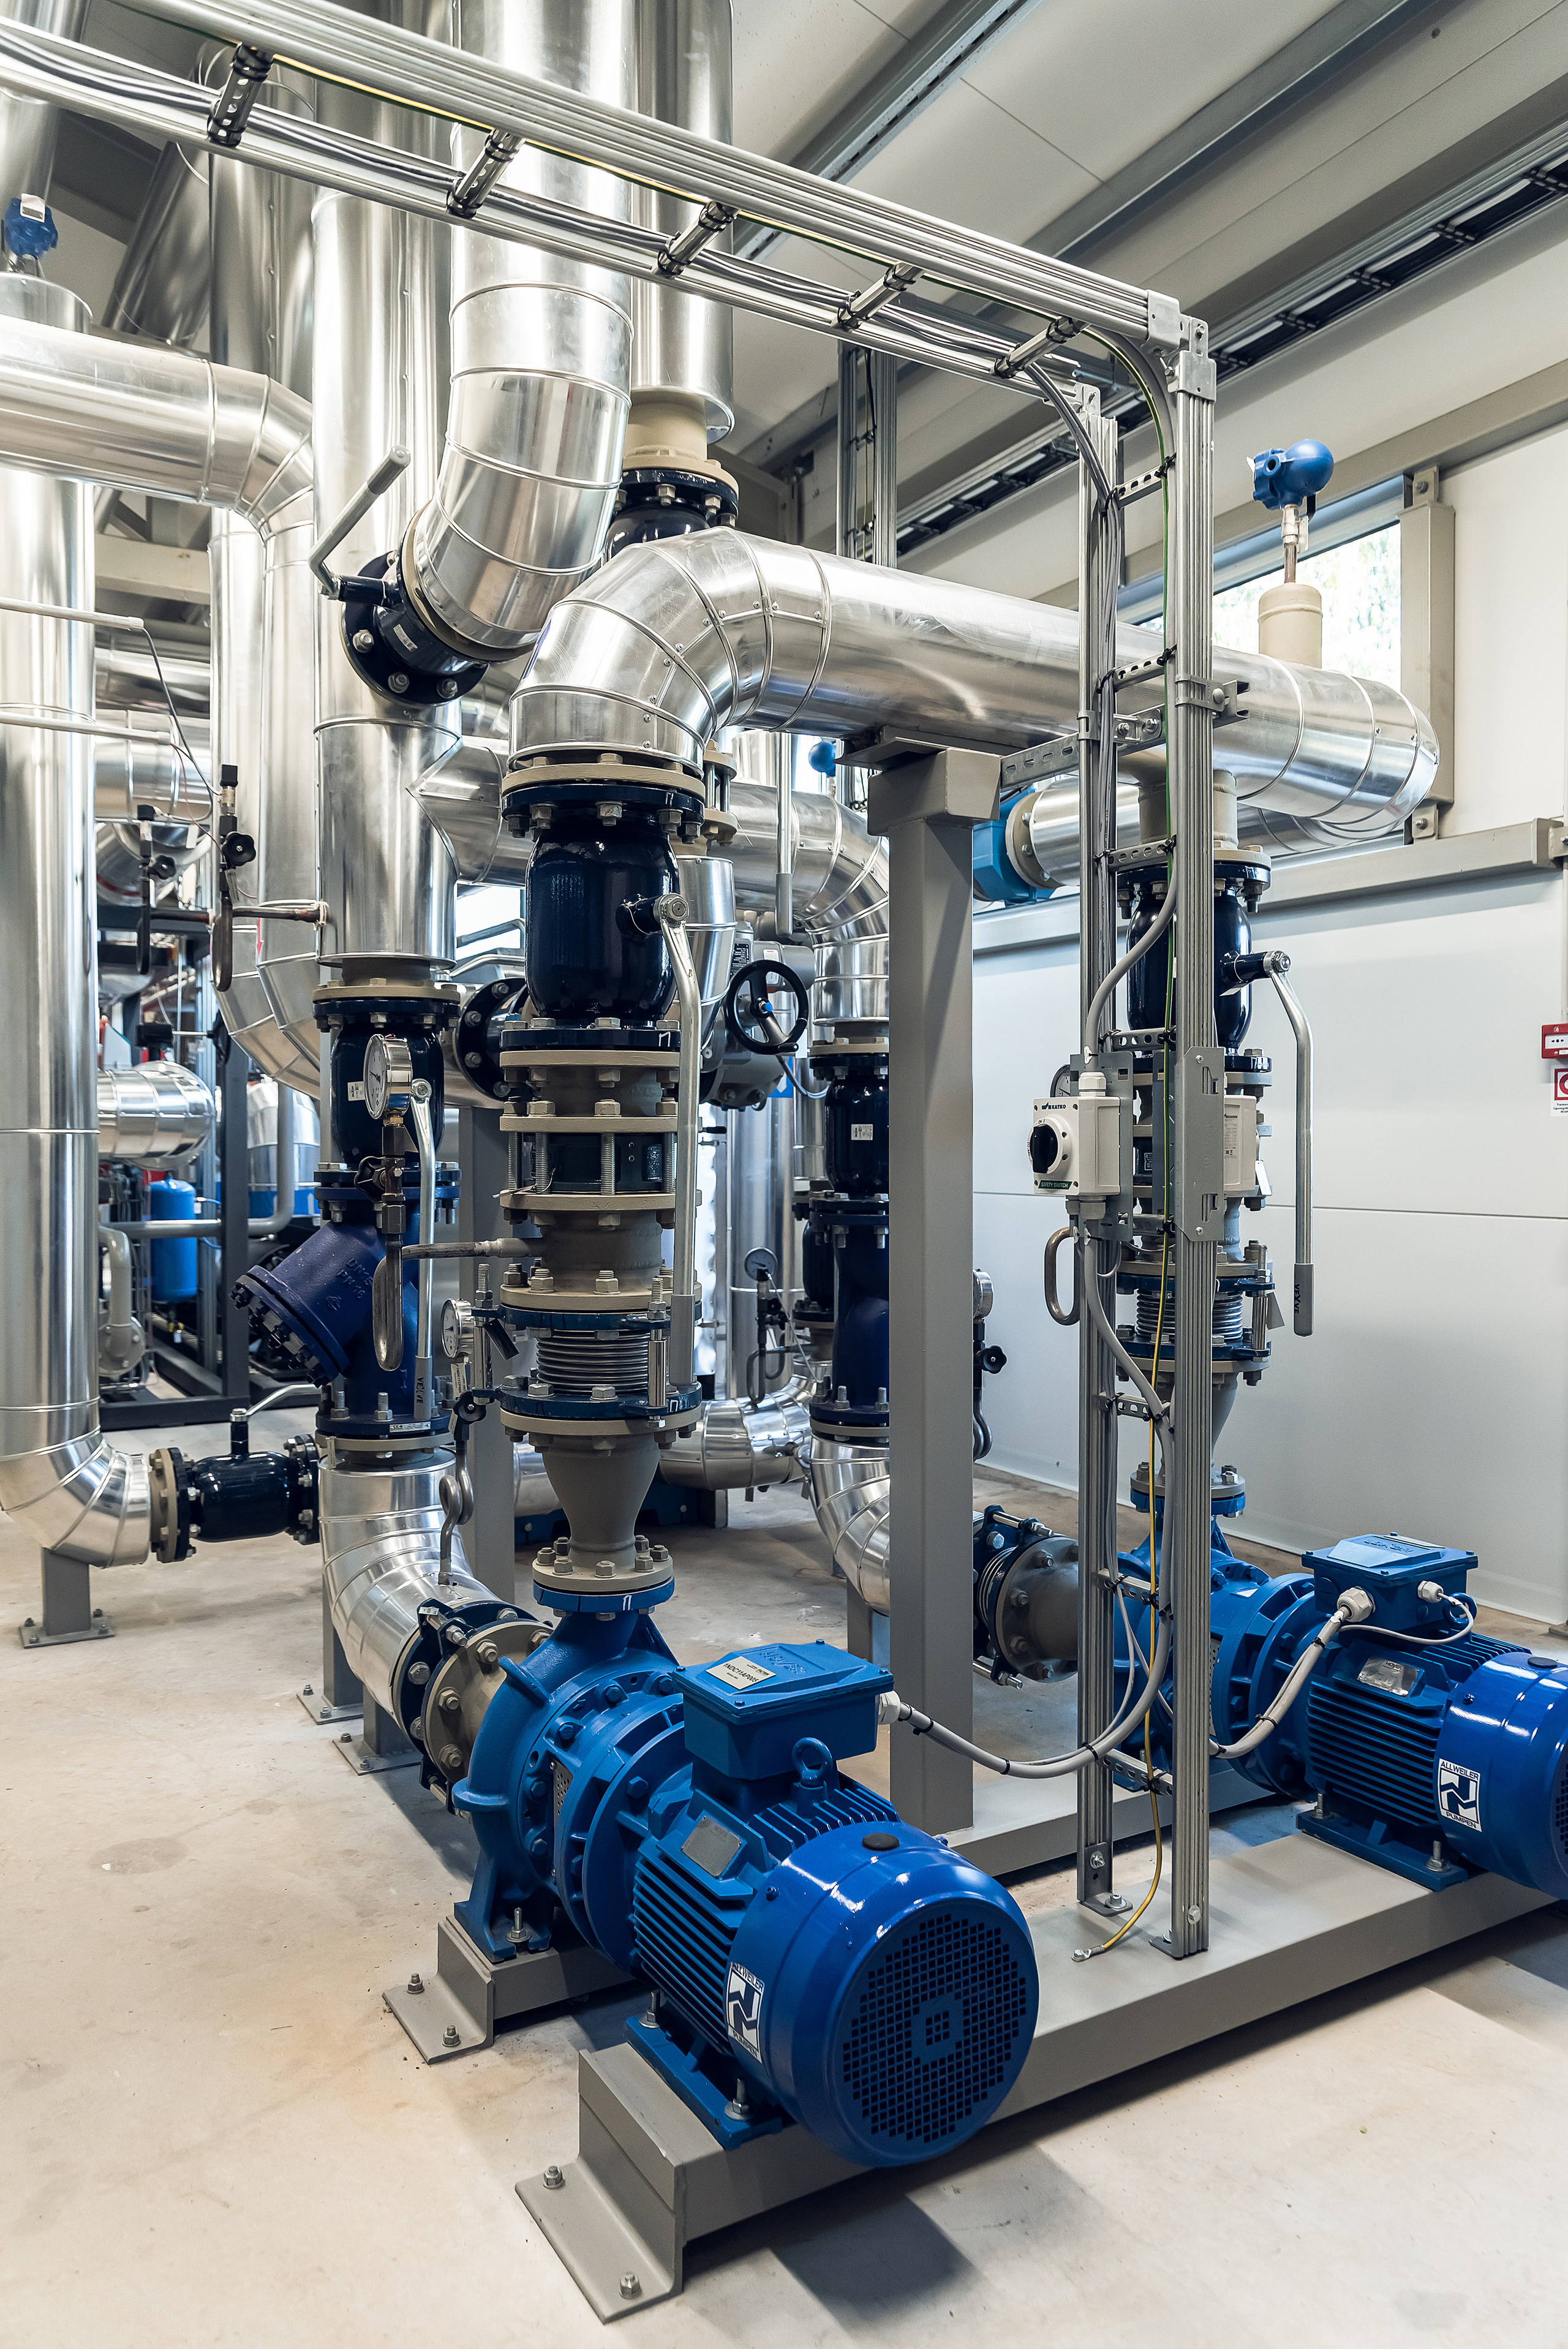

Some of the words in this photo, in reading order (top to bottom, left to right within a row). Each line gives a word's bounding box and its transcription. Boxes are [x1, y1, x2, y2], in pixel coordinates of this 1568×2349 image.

[345, 1258, 373, 1286] DN15
[417, 1377, 425, 1404] VEXVE
[1441, 1761, 1479, 1781] ALLWEILER
[1446, 1811, 1477, 1828] PUMPEN
[732, 1963, 764, 1993] ALLWEILER
[733, 2030, 758, 2058] PUMPEN
